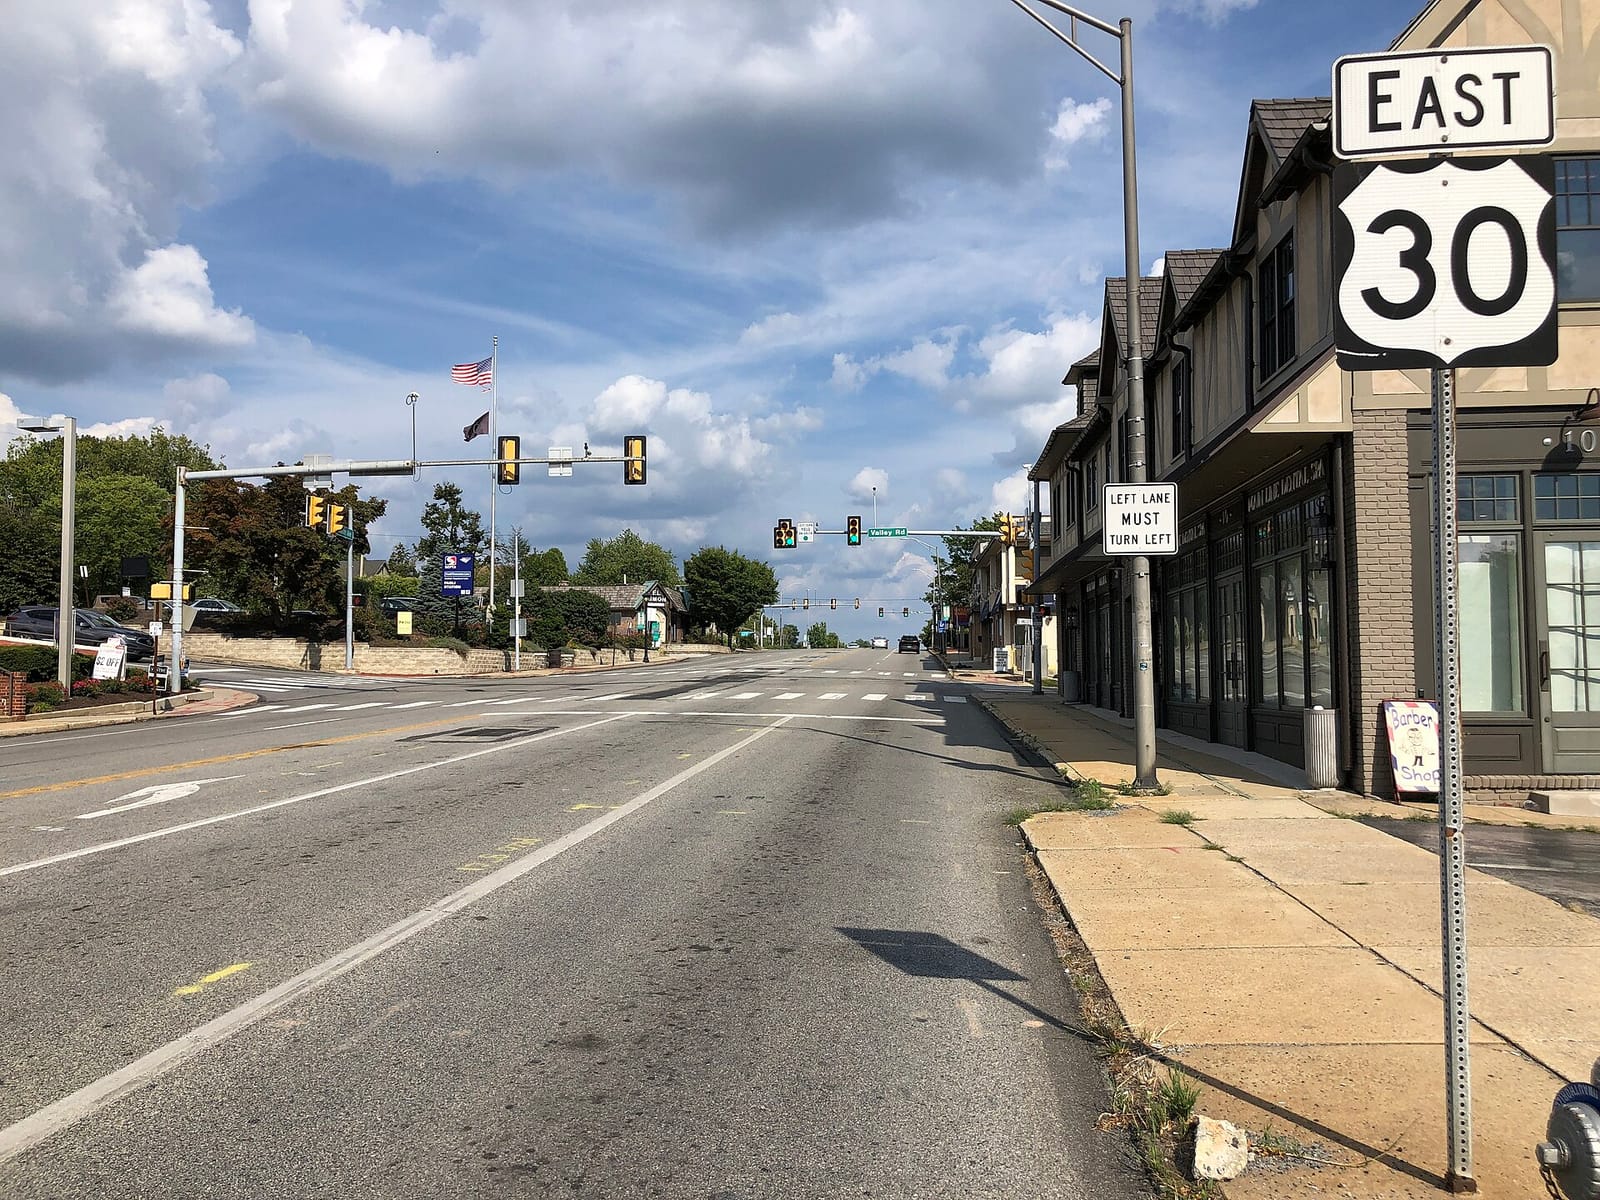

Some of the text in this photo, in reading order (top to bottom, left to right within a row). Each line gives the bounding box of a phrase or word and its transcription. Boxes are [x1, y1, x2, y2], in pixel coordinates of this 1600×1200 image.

[1368, 70, 1520, 133] EAST
[1361, 205, 1528, 320] 30
[1564, 429, 1596, 453] 10
[1111, 492, 1171, 504] LEFT LANE
[1121, 511, 1160, 526] MUST
[870, 528, 906, 537] Valley Rd
[1110, 534, 1138, 545] TURN
[1145, 533, 1171, 545] LEFT
[96, 656, 121, 667] $2 OFF
[1391, 708, 1433, 730] Barber
